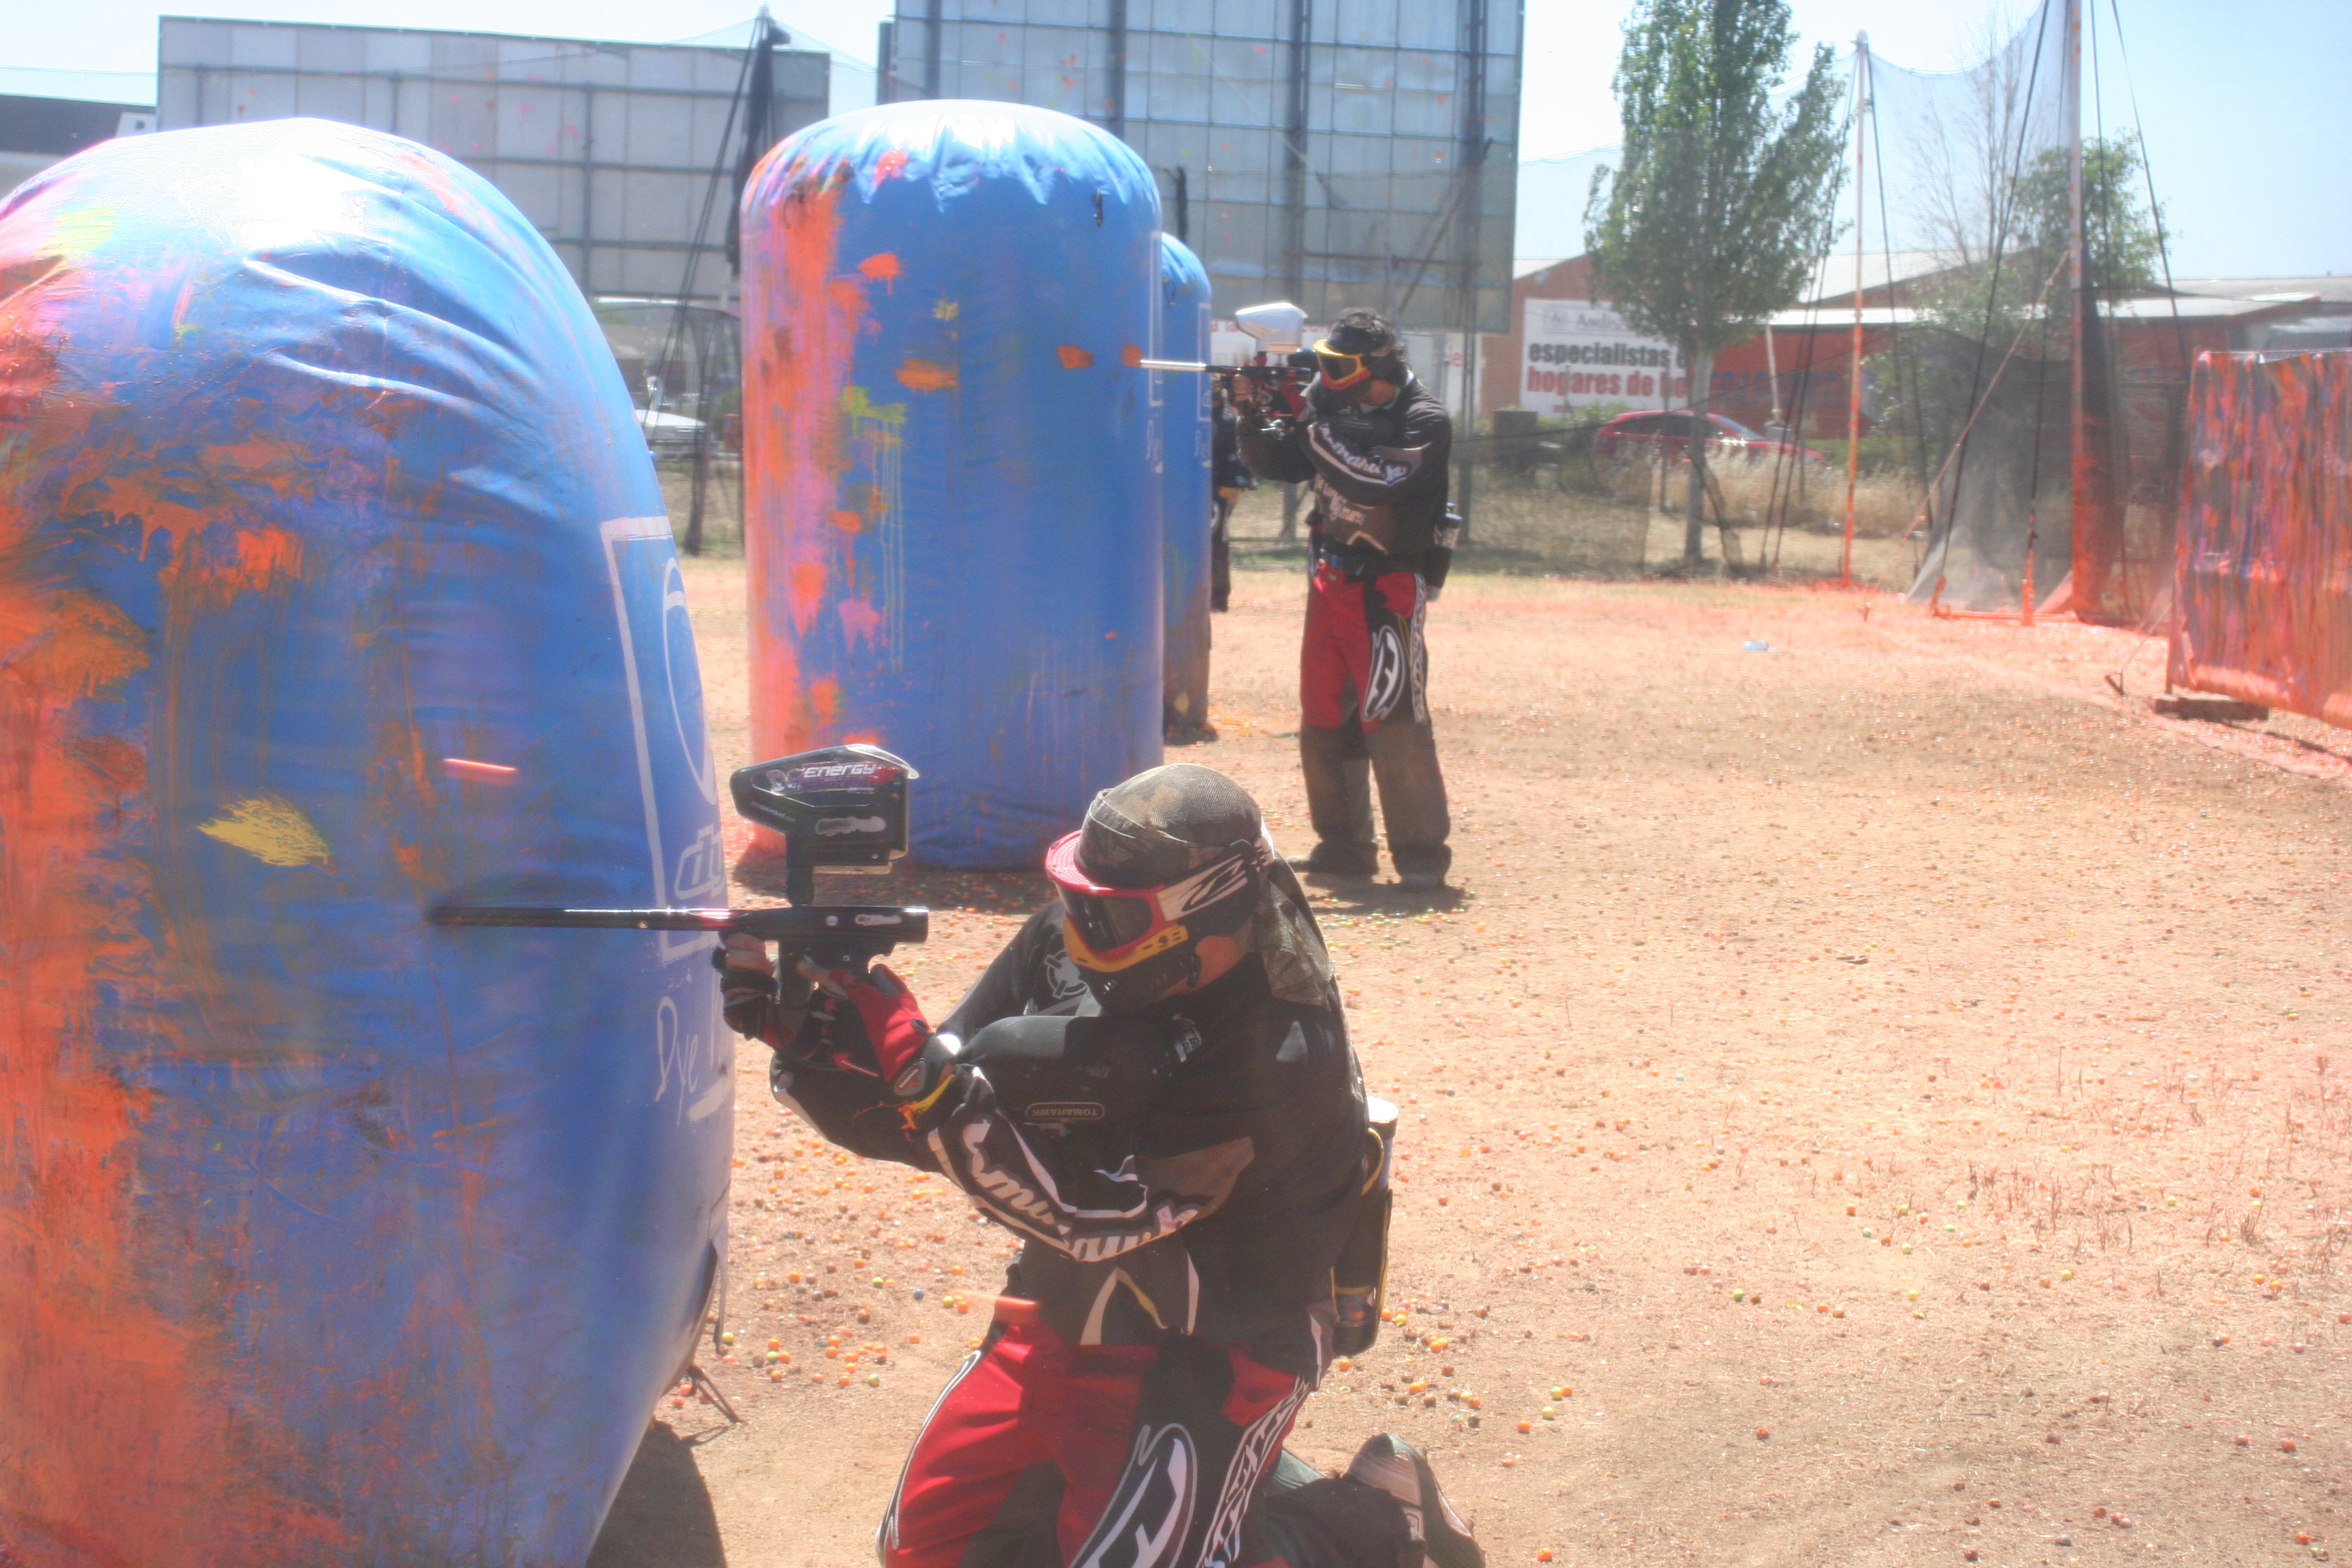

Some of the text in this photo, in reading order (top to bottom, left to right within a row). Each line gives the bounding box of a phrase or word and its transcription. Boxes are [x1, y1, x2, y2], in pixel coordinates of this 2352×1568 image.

[1529, 342, 1671, 368] especialistas
[1527, 365, 1622, 396] hogares
[1627, 370, 1654, 397] de
[1032, 1108, 1098, 1116] TOMAHAWK
